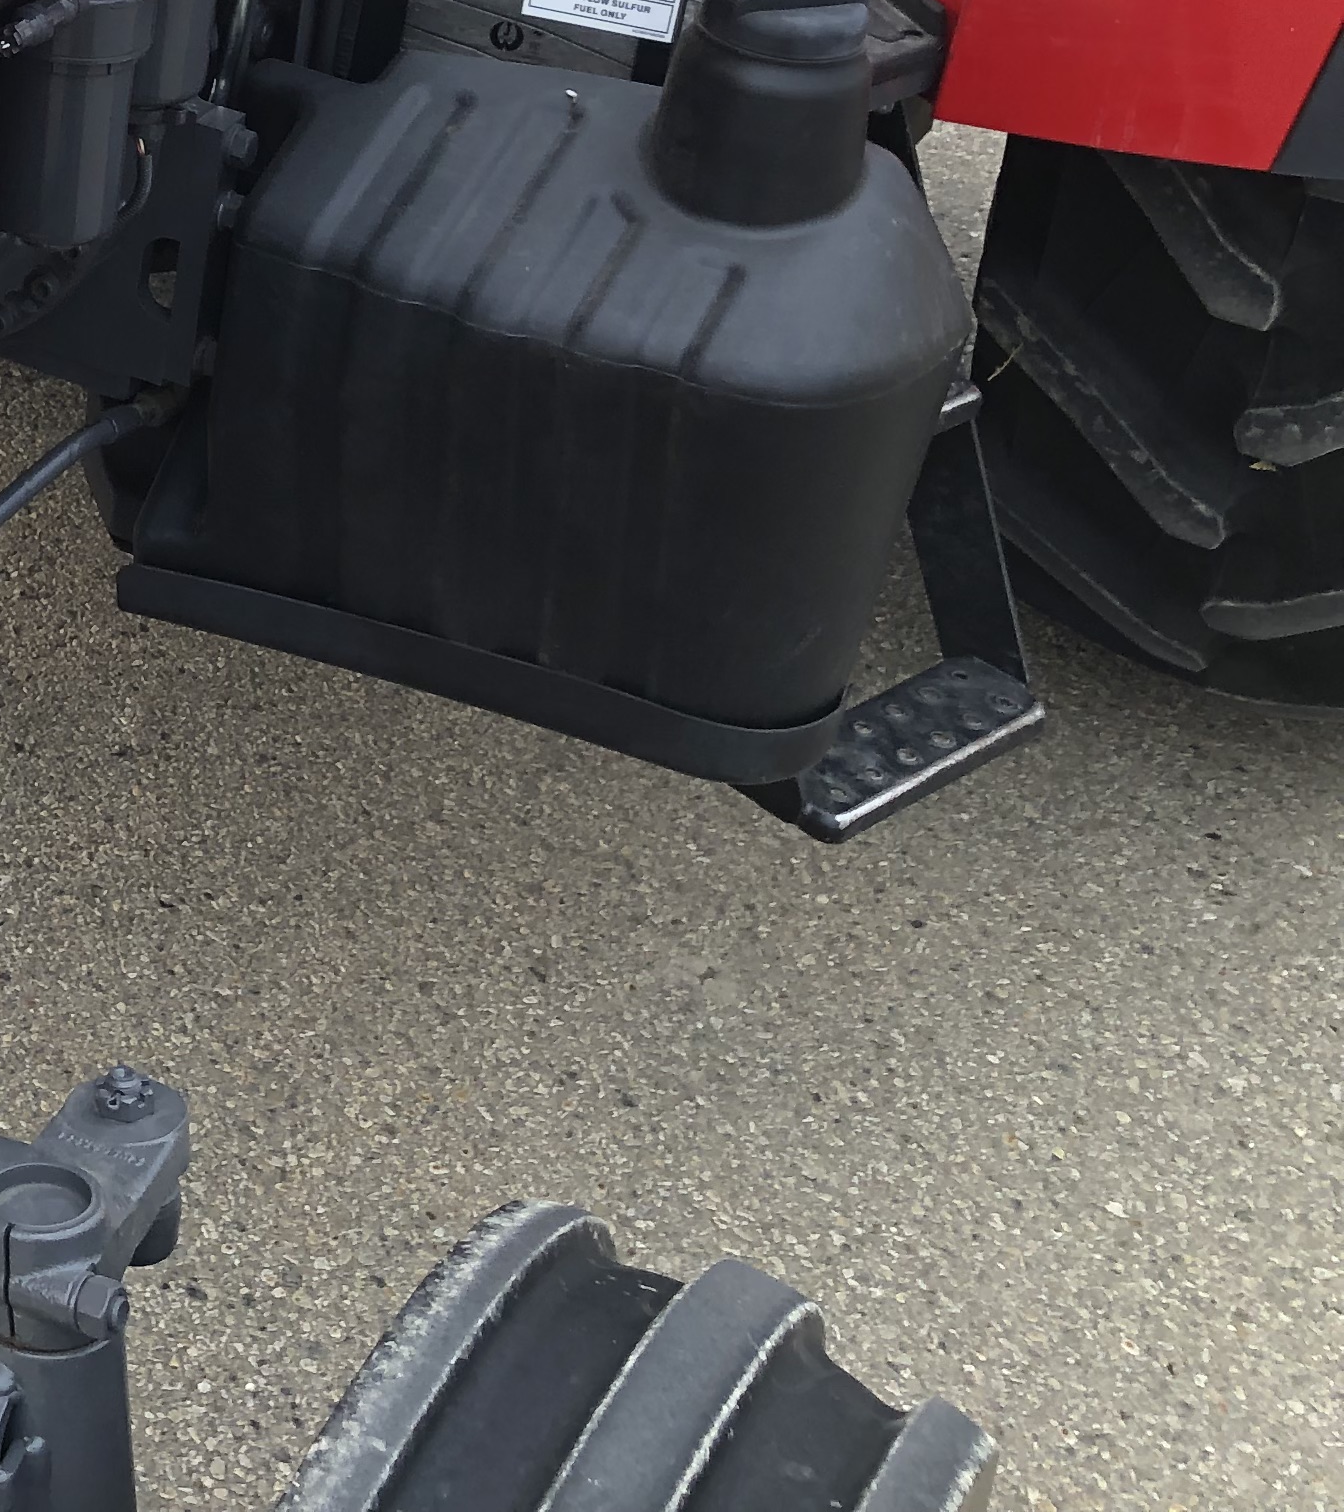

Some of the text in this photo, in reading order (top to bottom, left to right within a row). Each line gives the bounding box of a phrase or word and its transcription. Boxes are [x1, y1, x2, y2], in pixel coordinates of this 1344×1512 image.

[573, 3, 627, 20] FUEL ONLY
[612, 0, 651, 13] SULFUR
